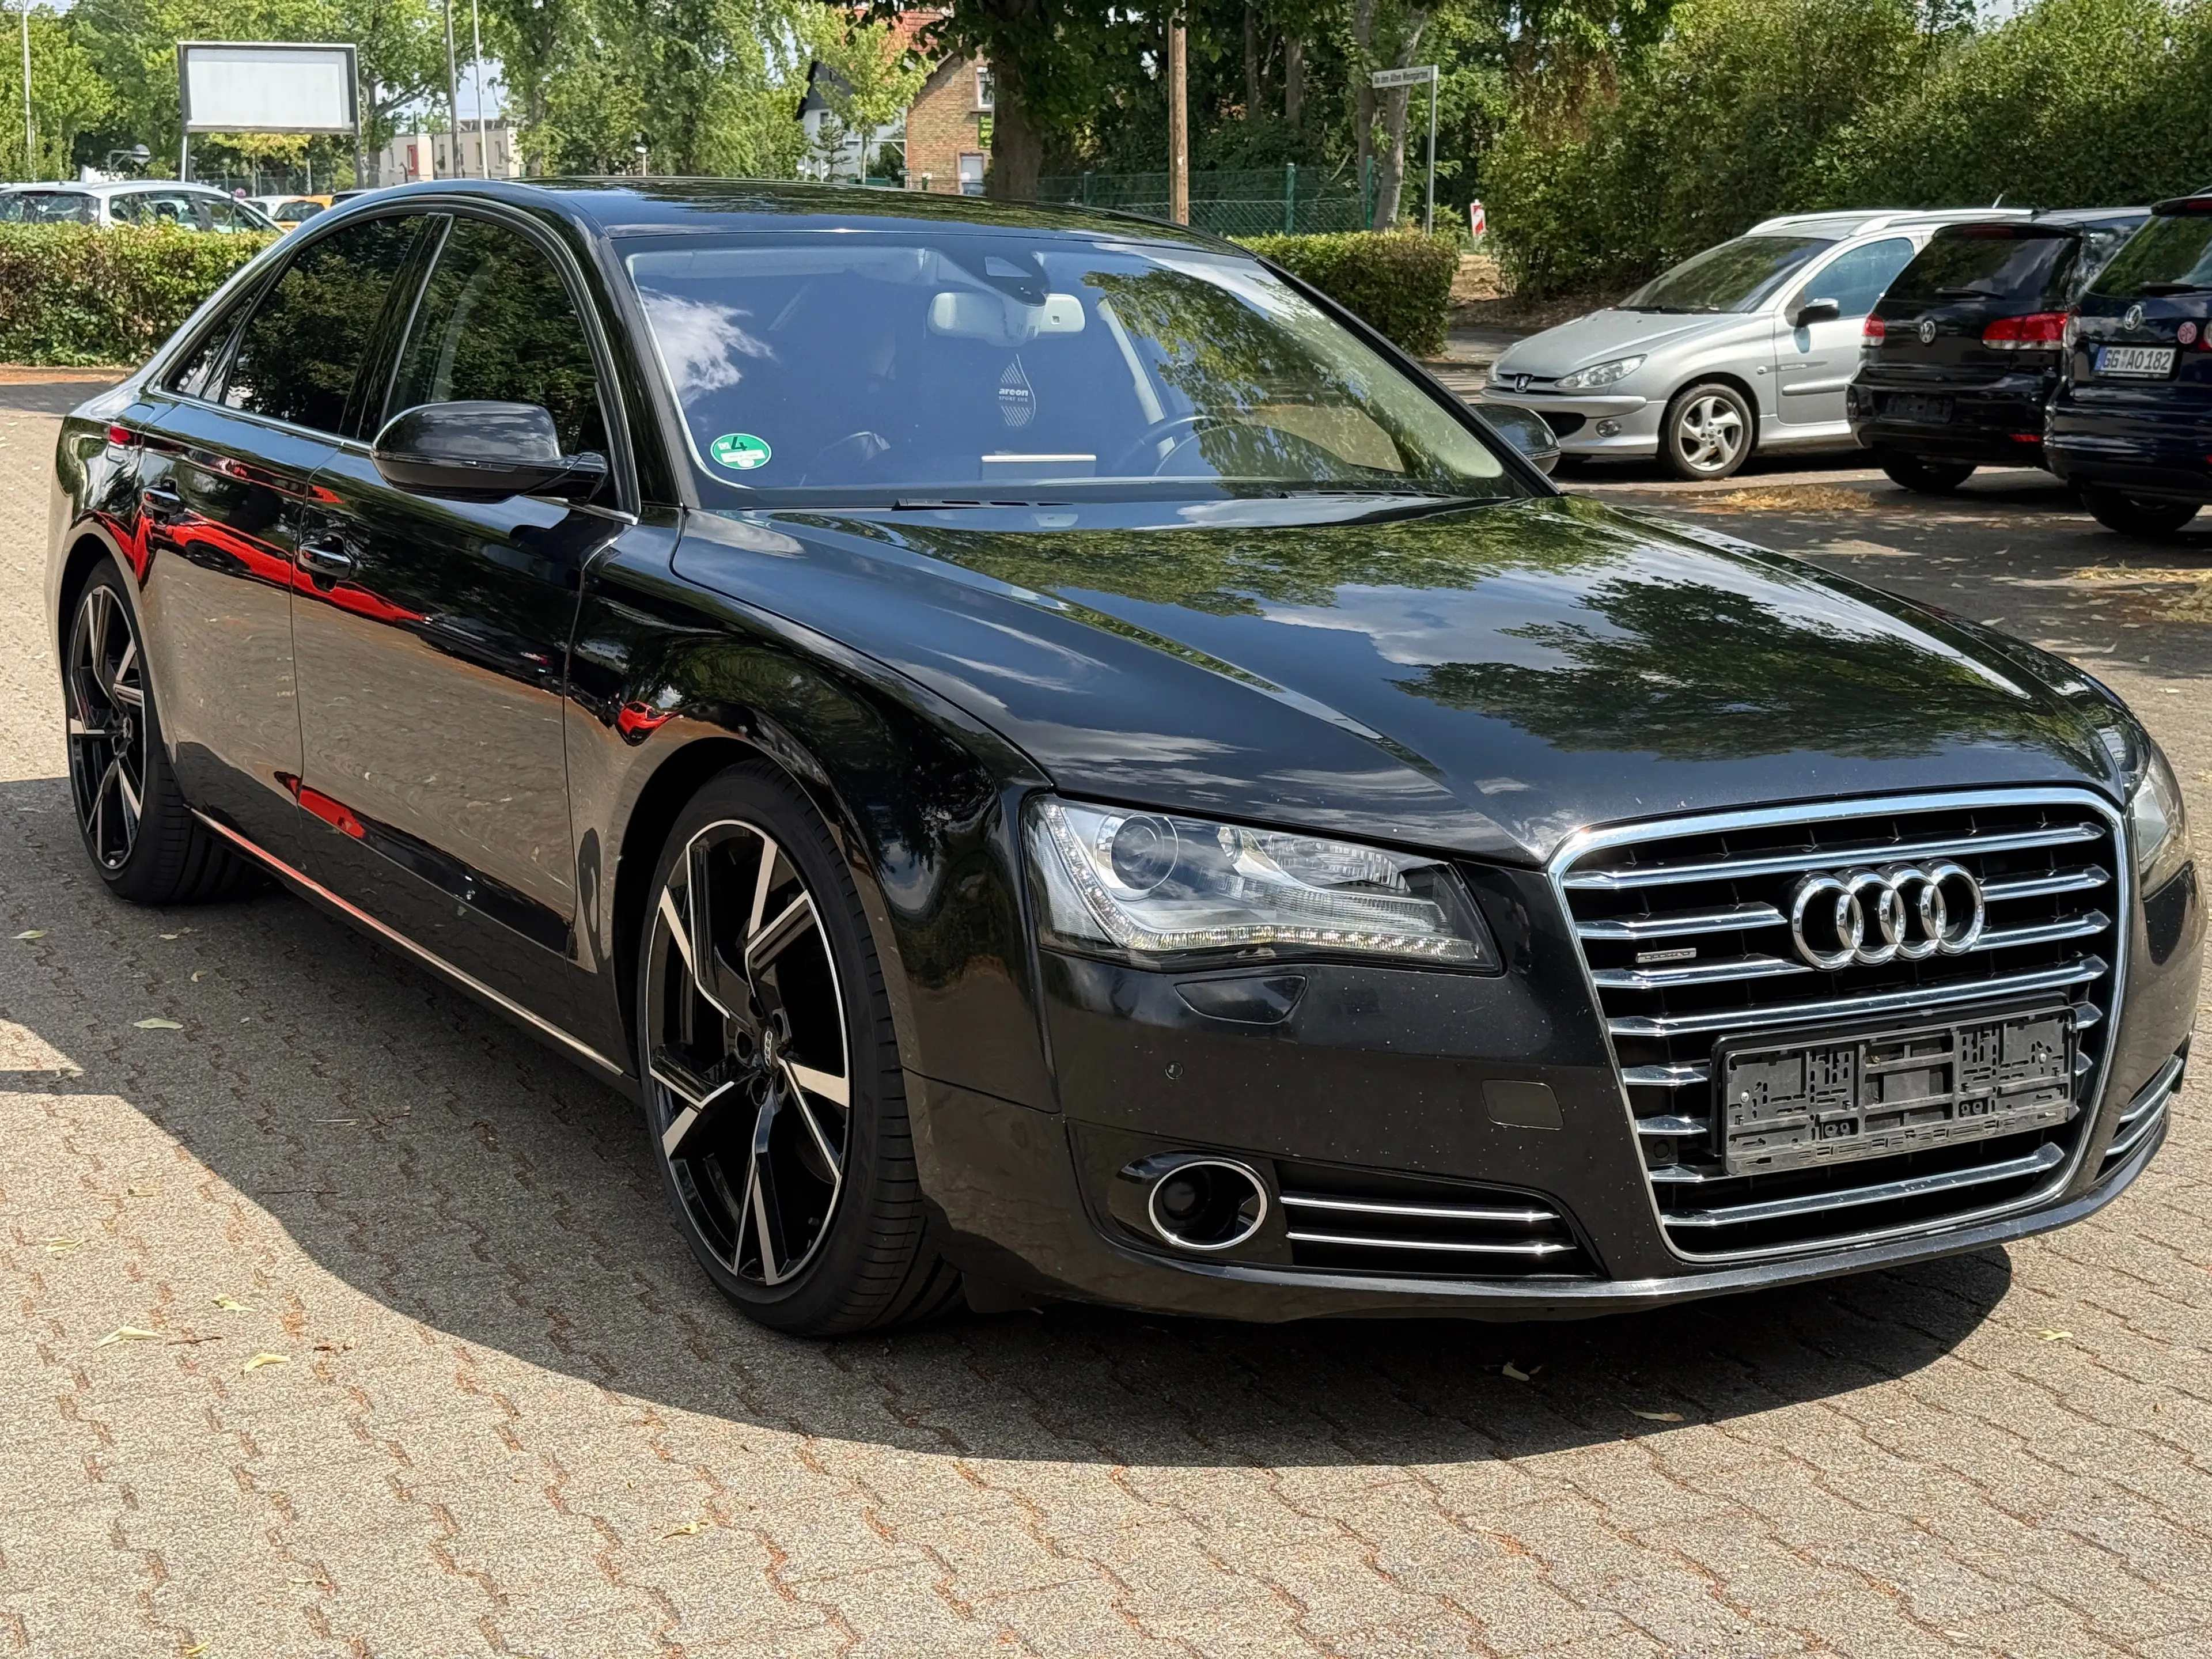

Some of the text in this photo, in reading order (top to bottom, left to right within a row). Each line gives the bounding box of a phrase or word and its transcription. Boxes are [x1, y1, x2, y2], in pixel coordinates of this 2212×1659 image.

[2103, 350, 2121, 369] GG
[999, 388, 1029, 396] areon
[731, 436, 748, 451] 4
